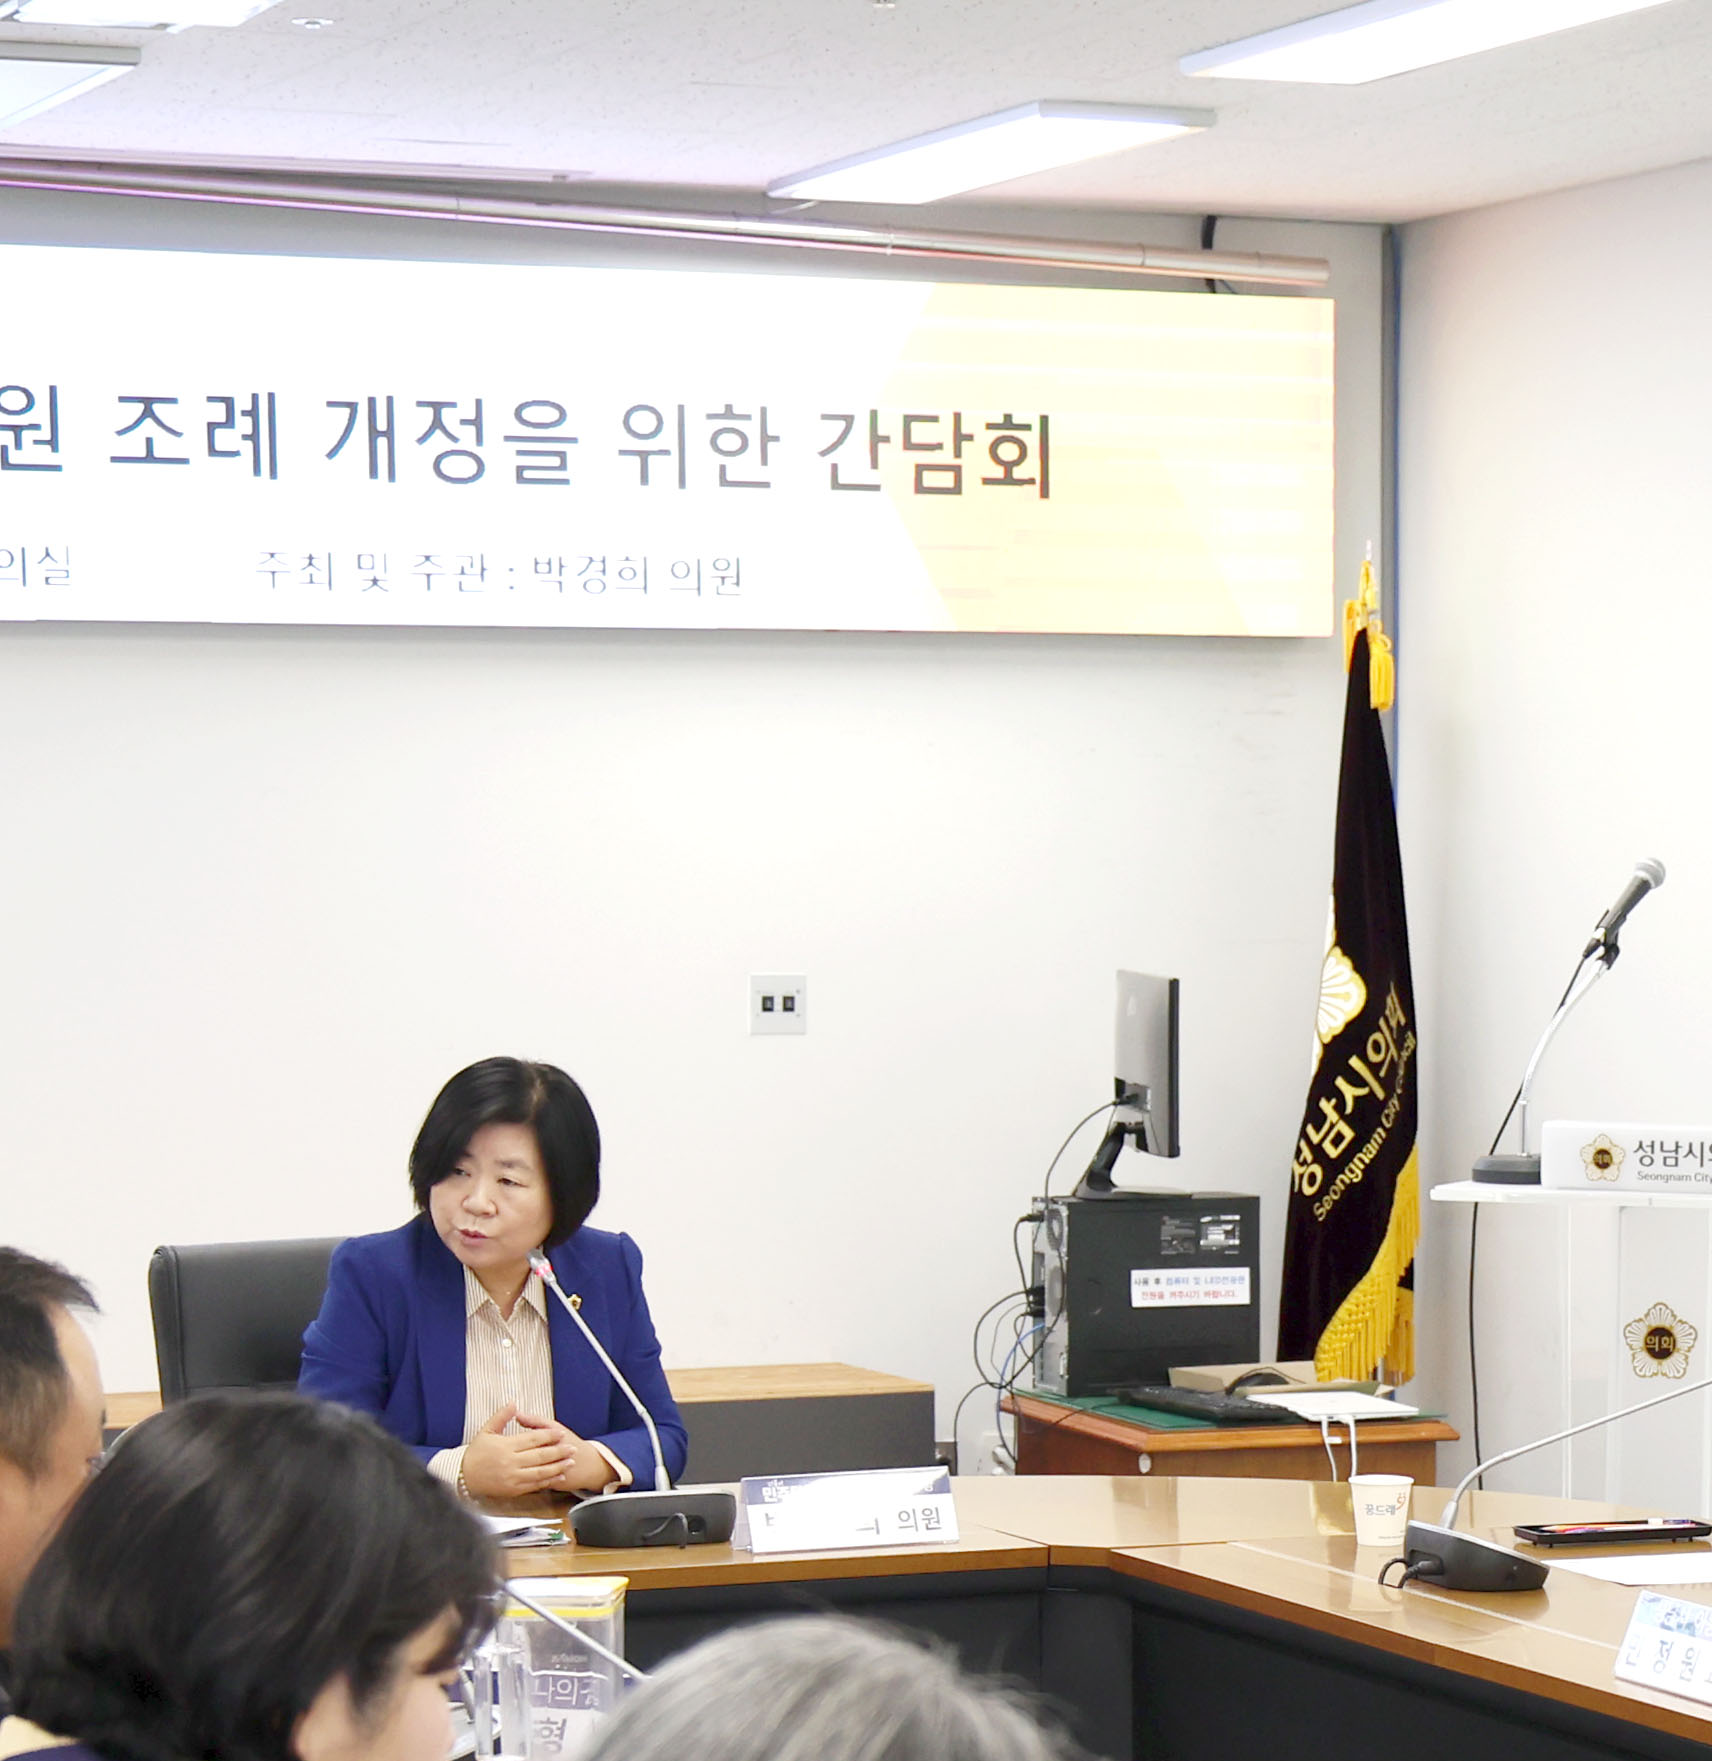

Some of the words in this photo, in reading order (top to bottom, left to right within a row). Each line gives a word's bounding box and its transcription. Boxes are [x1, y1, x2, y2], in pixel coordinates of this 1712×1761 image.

[110, 392, 278, 480] 조례
[325, 395, 579, 486] 개정을
[618, 404, 780, 489] 위한
[818, 409, 1052, 501] 간담회
[255, 551, 333, 592] 주최
[356, 553, 389, 593] 및
[414, 553, 489, 593] 주관
[533, 555, 648, 595] 박경희
[670, 557, 744, 597] 의원
[1292, 981, 1406, 1196] 성남시의회
[1313, 1126, 1387, 1222] Seongnam
[1637, 1171, 1692, 1184] Seongnam
[1646, 1336, 1674, 1353] 의회
[897, 1506, 942, 1532] 의원
